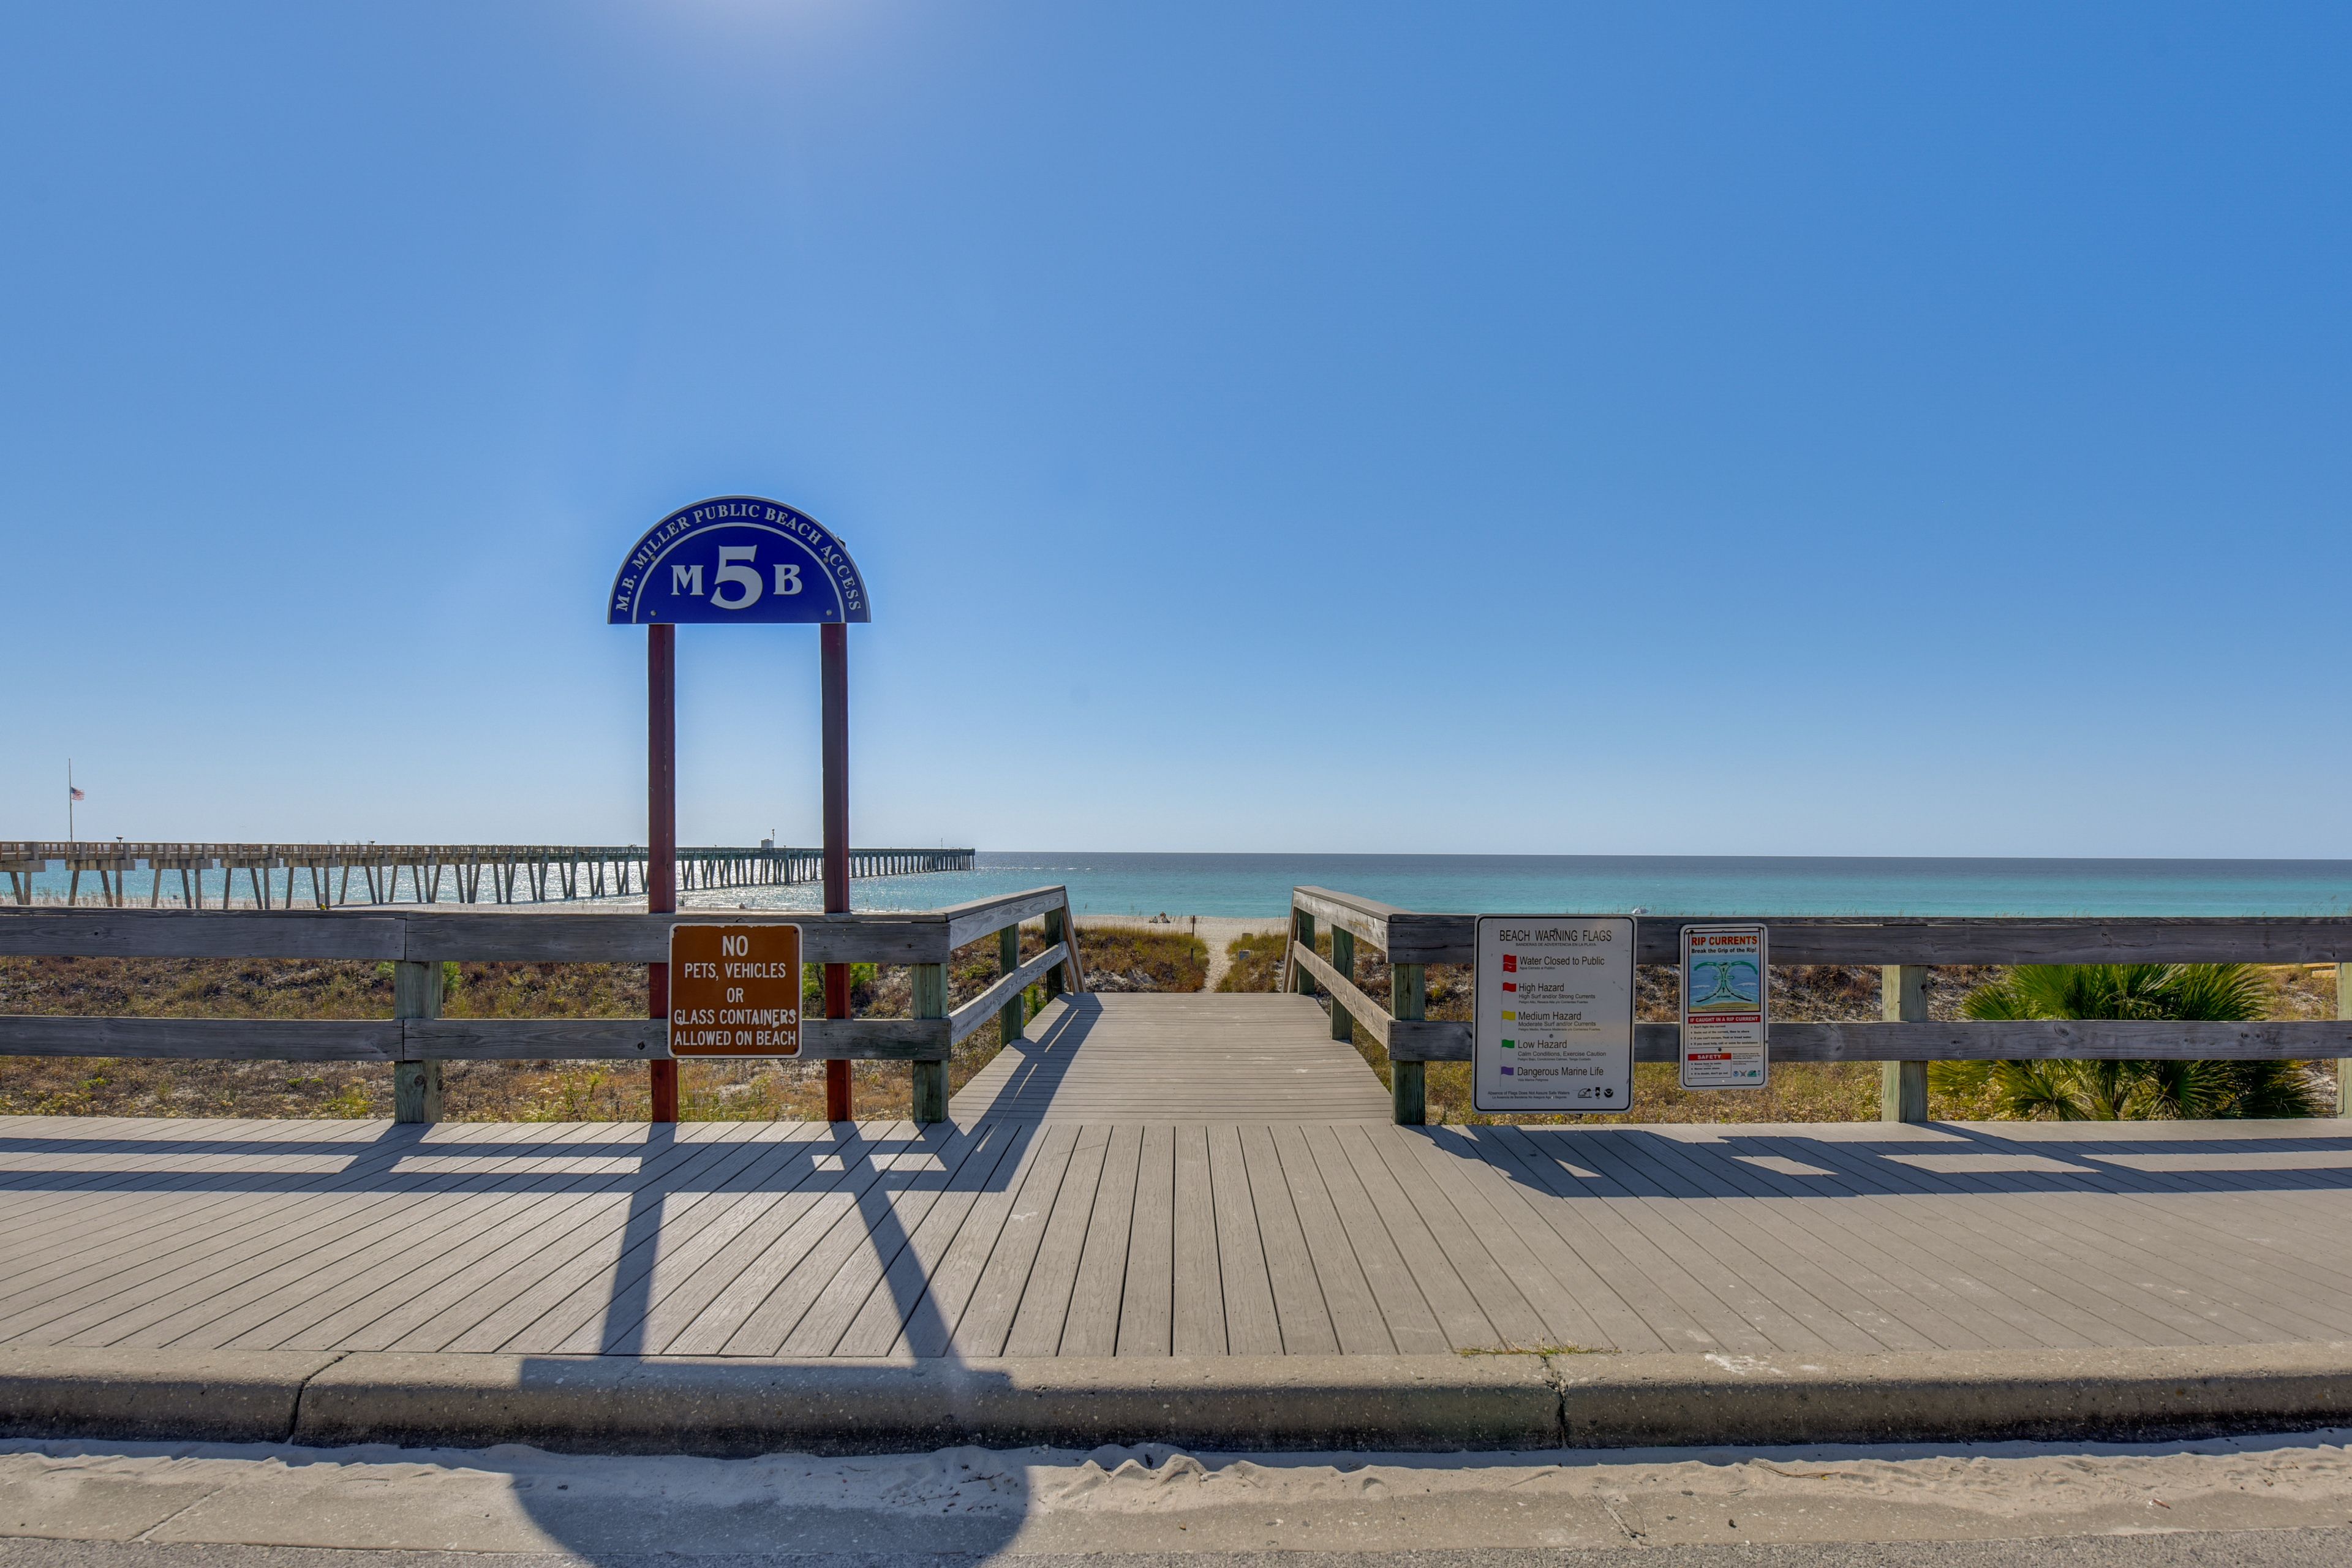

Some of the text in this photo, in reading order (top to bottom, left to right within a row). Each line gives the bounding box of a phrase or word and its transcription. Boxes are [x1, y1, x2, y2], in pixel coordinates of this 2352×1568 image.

[616, 503, 861, 612] M.B. MILLER PUBLIC BEACH ACCESS
[671, 545, 802, 610] M 5 B
[1500, 930, 1612, 941] BEACH WARNING FLAGS
[1692, 936, 1757, 946] RIP CURRENTS
[722, 935, 748, 956] NO
[1520, 956, 1605, 965] Water Closed to Public
[685, 963, 786, 981] PETS, VEHICLES
[1519, 983, 1564, 993] High Hazard
[726, 987, 744, 1003] OR
[674, 1009, 796, 1026] GLASS CONTAINERS
[1518, 1012, 1581, 1020] Medium Hazard
[674, 1031, 796, 1046] ALLOWED ON BEACH
[1518, 1040, 1567, 1049] Low Hazard
[1518, 1067, 1604, 1078] Dangerous Marine Life
